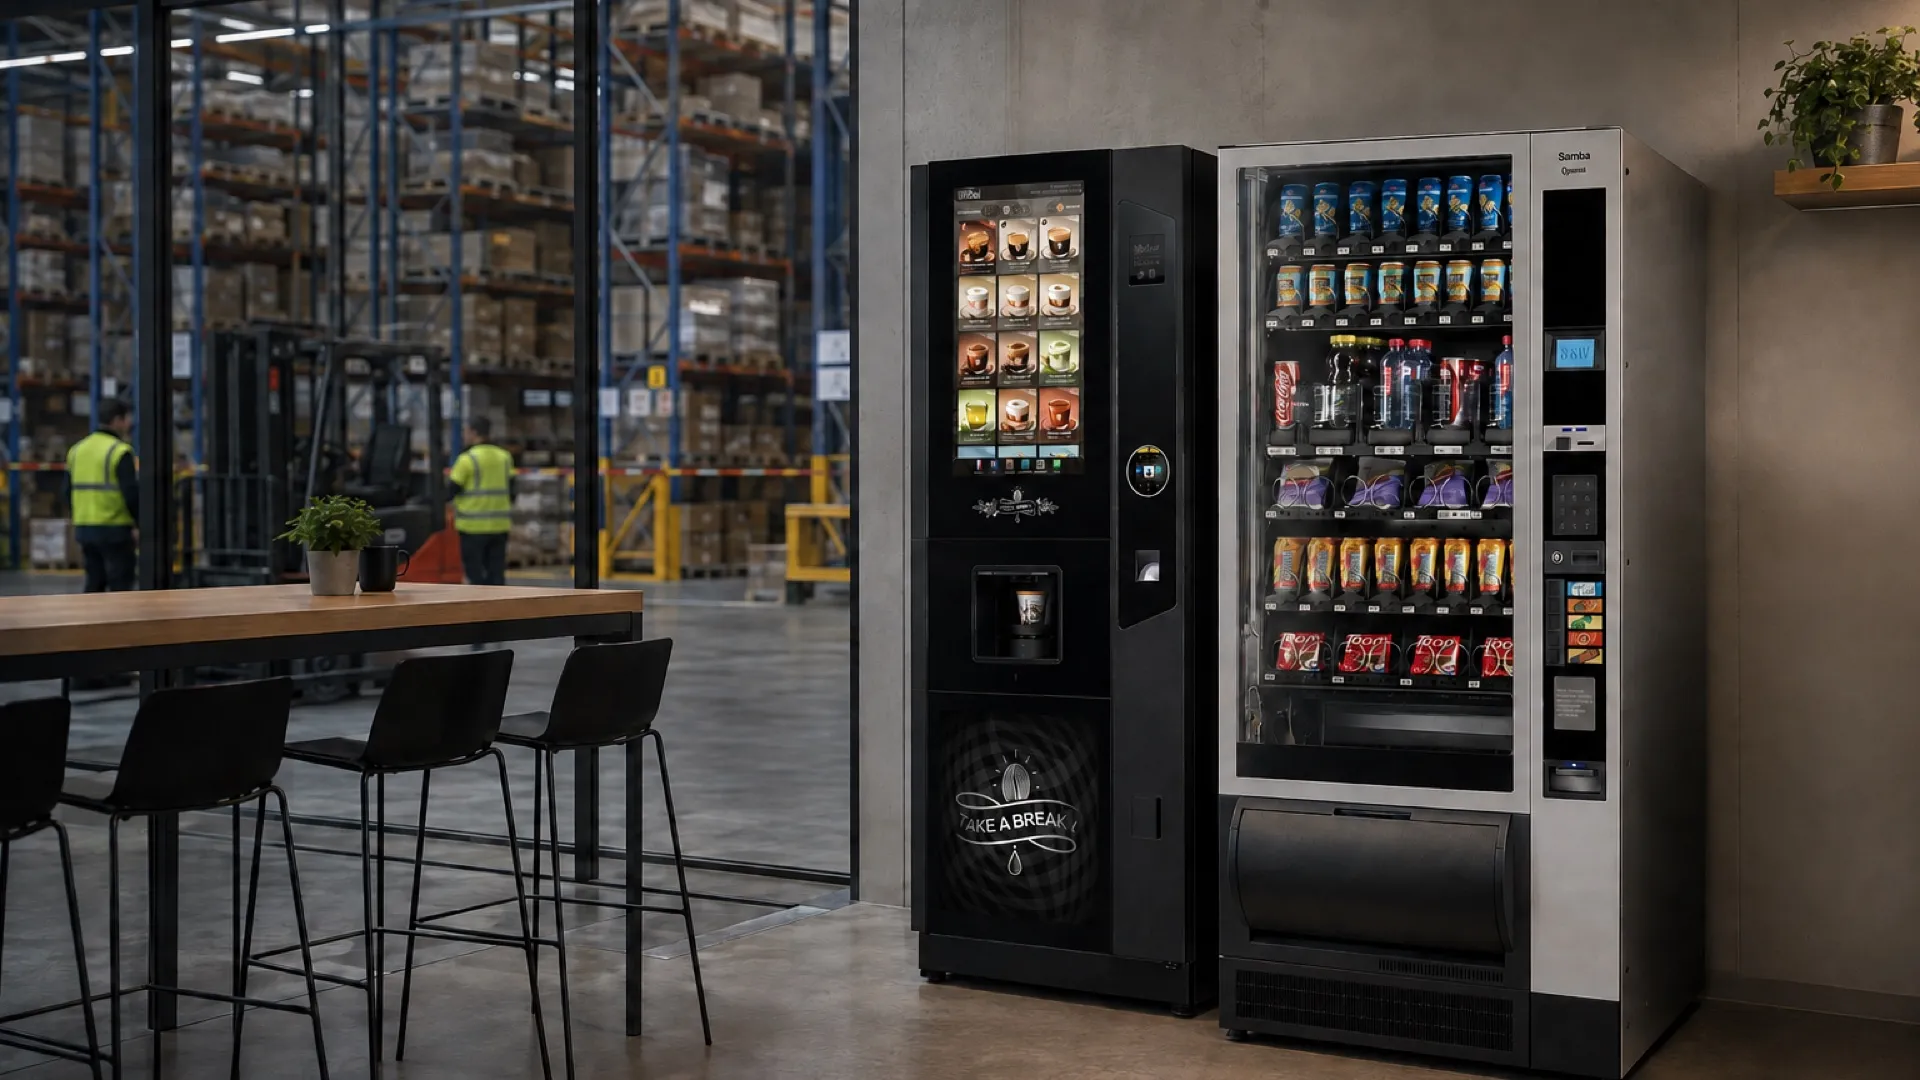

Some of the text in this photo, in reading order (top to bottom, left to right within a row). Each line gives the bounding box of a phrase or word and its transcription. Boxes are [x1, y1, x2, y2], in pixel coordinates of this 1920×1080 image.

[1558, 151, 1590, 161] Samba
[960, 813, 997, 833] TAKE
[1000, 816, 1011, 831] A
[1012, 811, 1067, 830] BREAK
